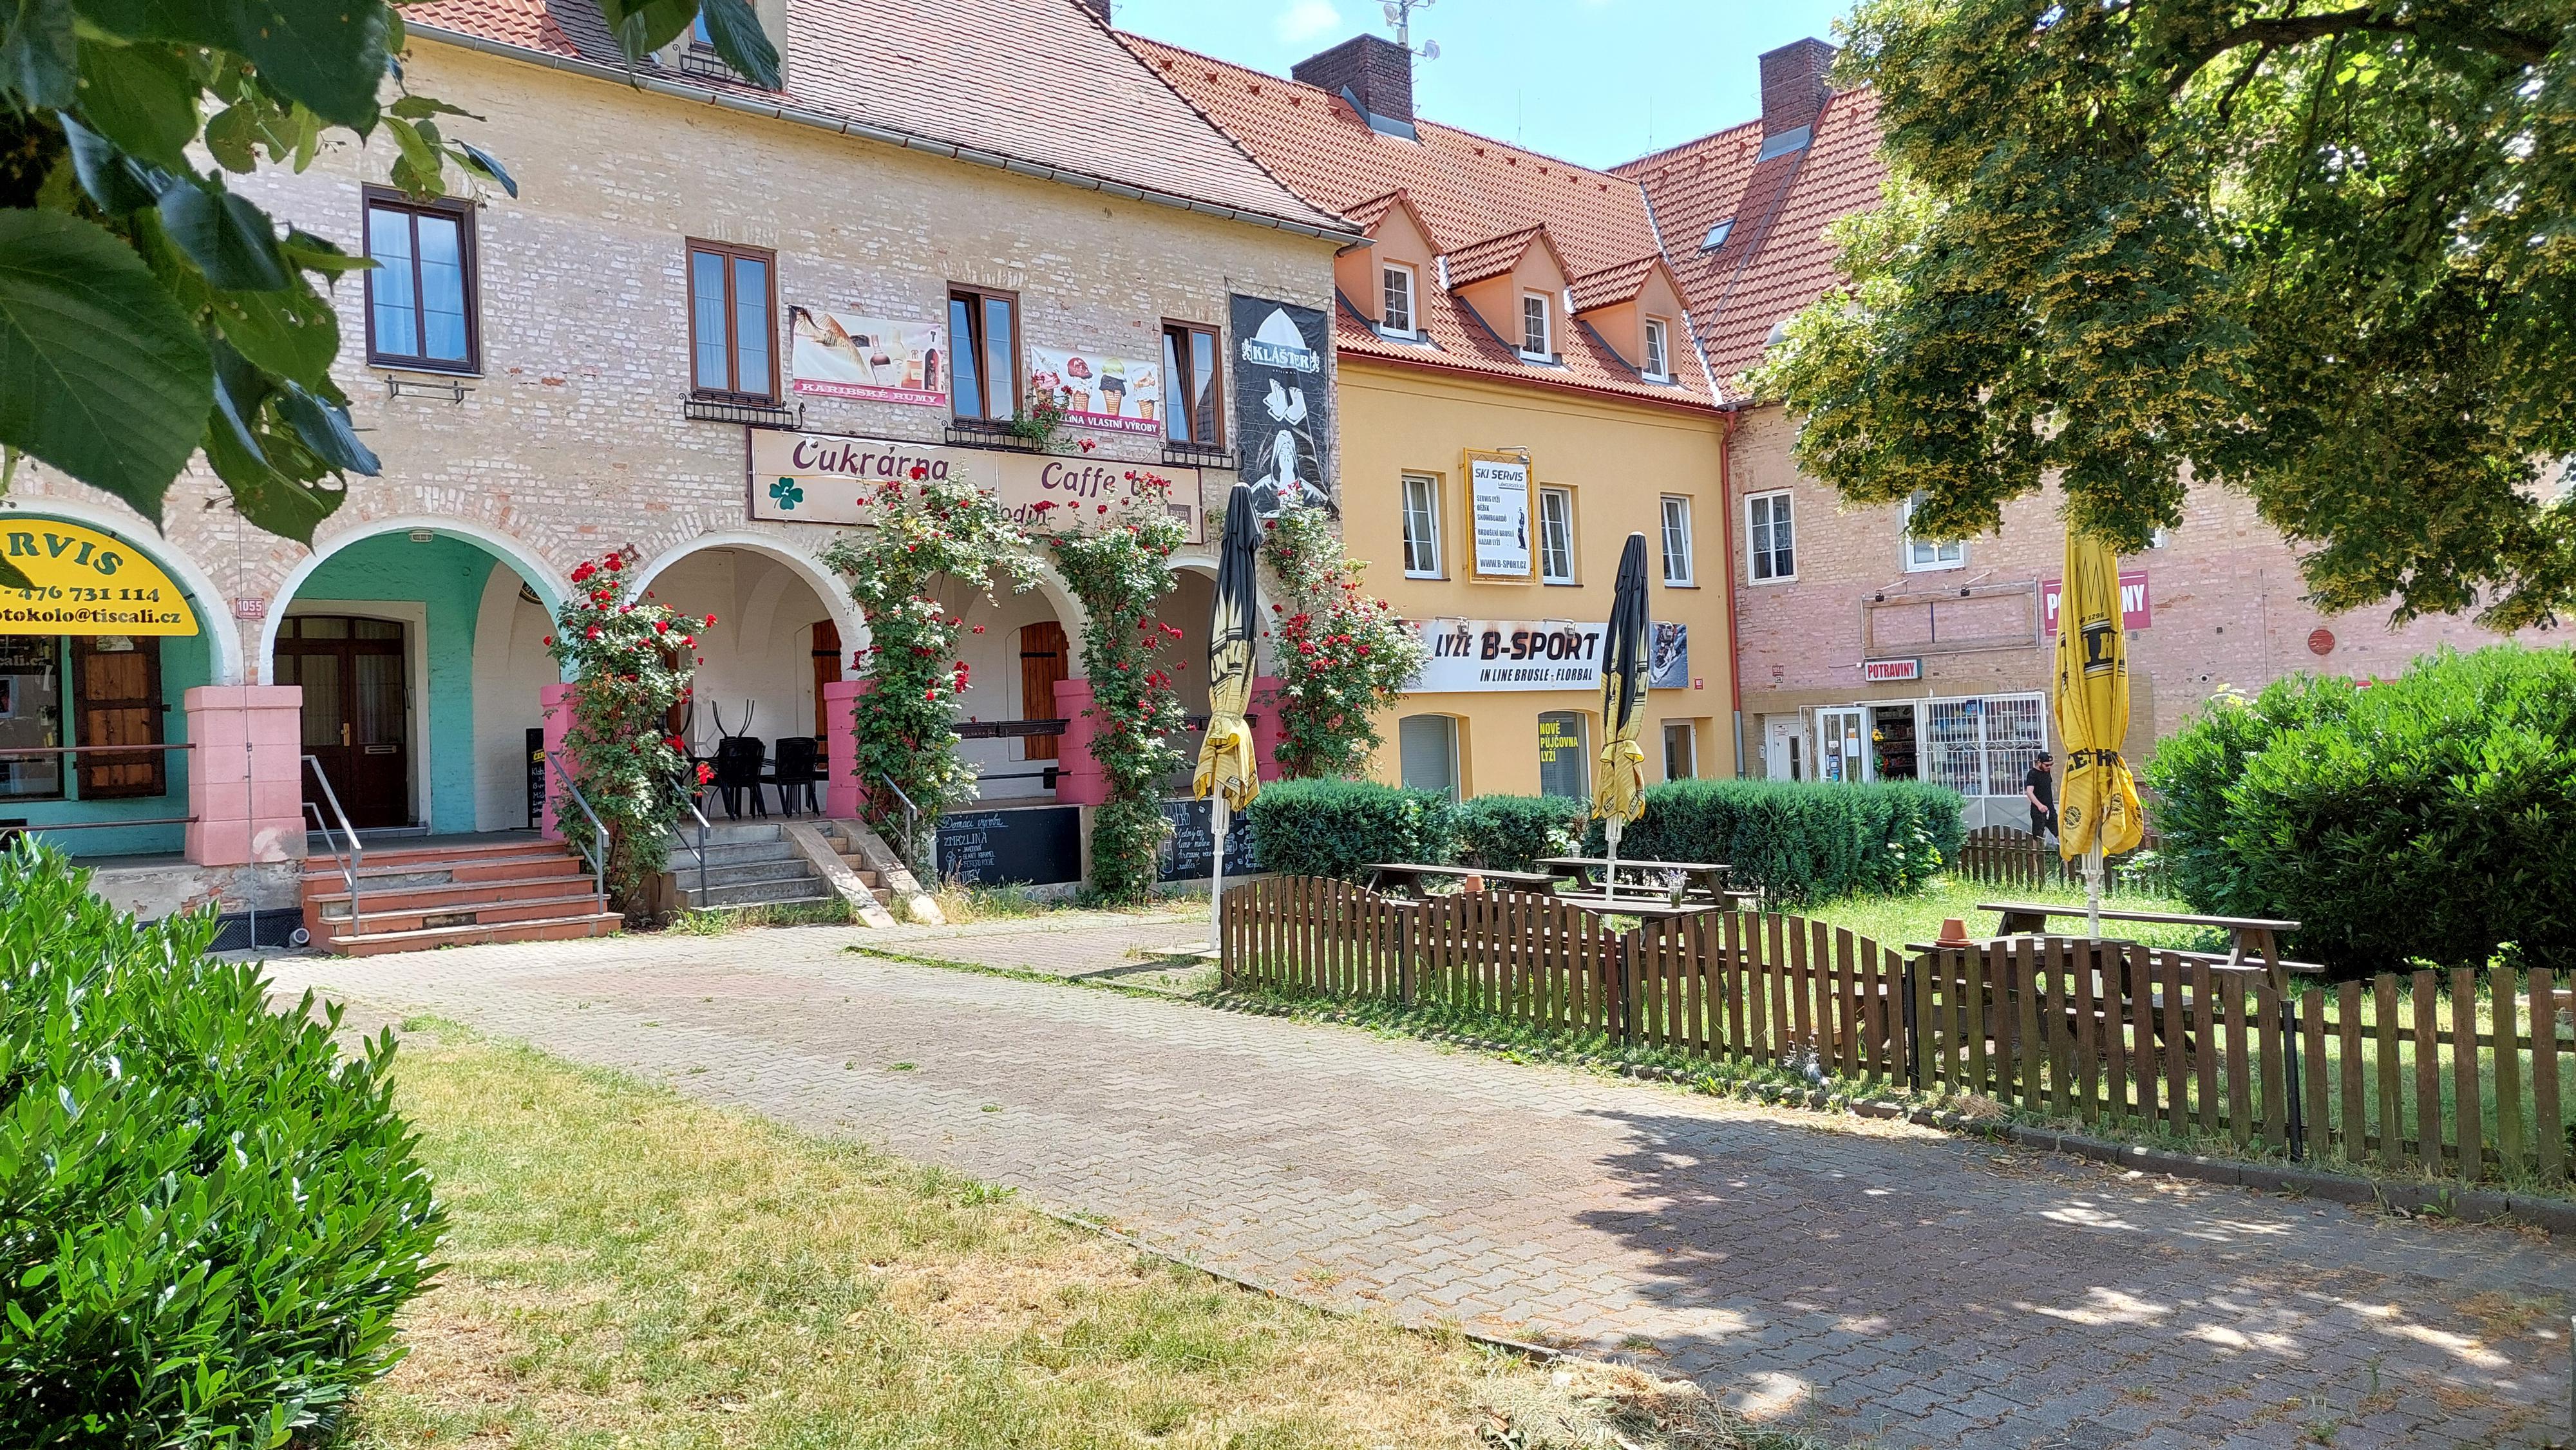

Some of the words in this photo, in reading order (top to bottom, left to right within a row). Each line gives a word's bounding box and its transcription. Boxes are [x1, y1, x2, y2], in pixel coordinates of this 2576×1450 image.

[1252, 346, 1309, 369] KLÁŠTER
[800, 382, 889, 399] KARIBSKÉ
[893, 392, 938, 404] RUMY
[1087, 417, 1122, 429] VLASTNÍ
[1124, 420, 1157, 433] VÝROBY
[792, 440, 949, 480] Cukrárna
[1041, 462, 1116, 498] Caffe
[1130, 470, 1171, 498] br
[1475, 467, 1490, 478] SKI
[1492, 469, 1524, 482] SERVIS
[1480, 559, 1527, 569] WWW.B-SPORT.CZ
[18, 586, 62, 601] 476
[69, 587, 111, 602] 731
[119, 588, 160, 603] 114
[238, 600, 262, 612] 1055
[2088, 612, 2105, 621] 1298
[1481, 631, 1600, 661] B-SPORT
[1480, 668, 1491, 682] IN
[1492, 668, 1513, 682] LINE
[1514, 668, 1550, 682] BRUSLE
[1555, 668, 1593, 681] FLORBAL
[1868, 662, 1915, 679] POTRAVINY
[1539, 720, 1560, 735] NOVĚ
[1540, 735, 1578, 748] PŮJČOVNA
[1540, 748, 1557, 762] LYŽÍ
